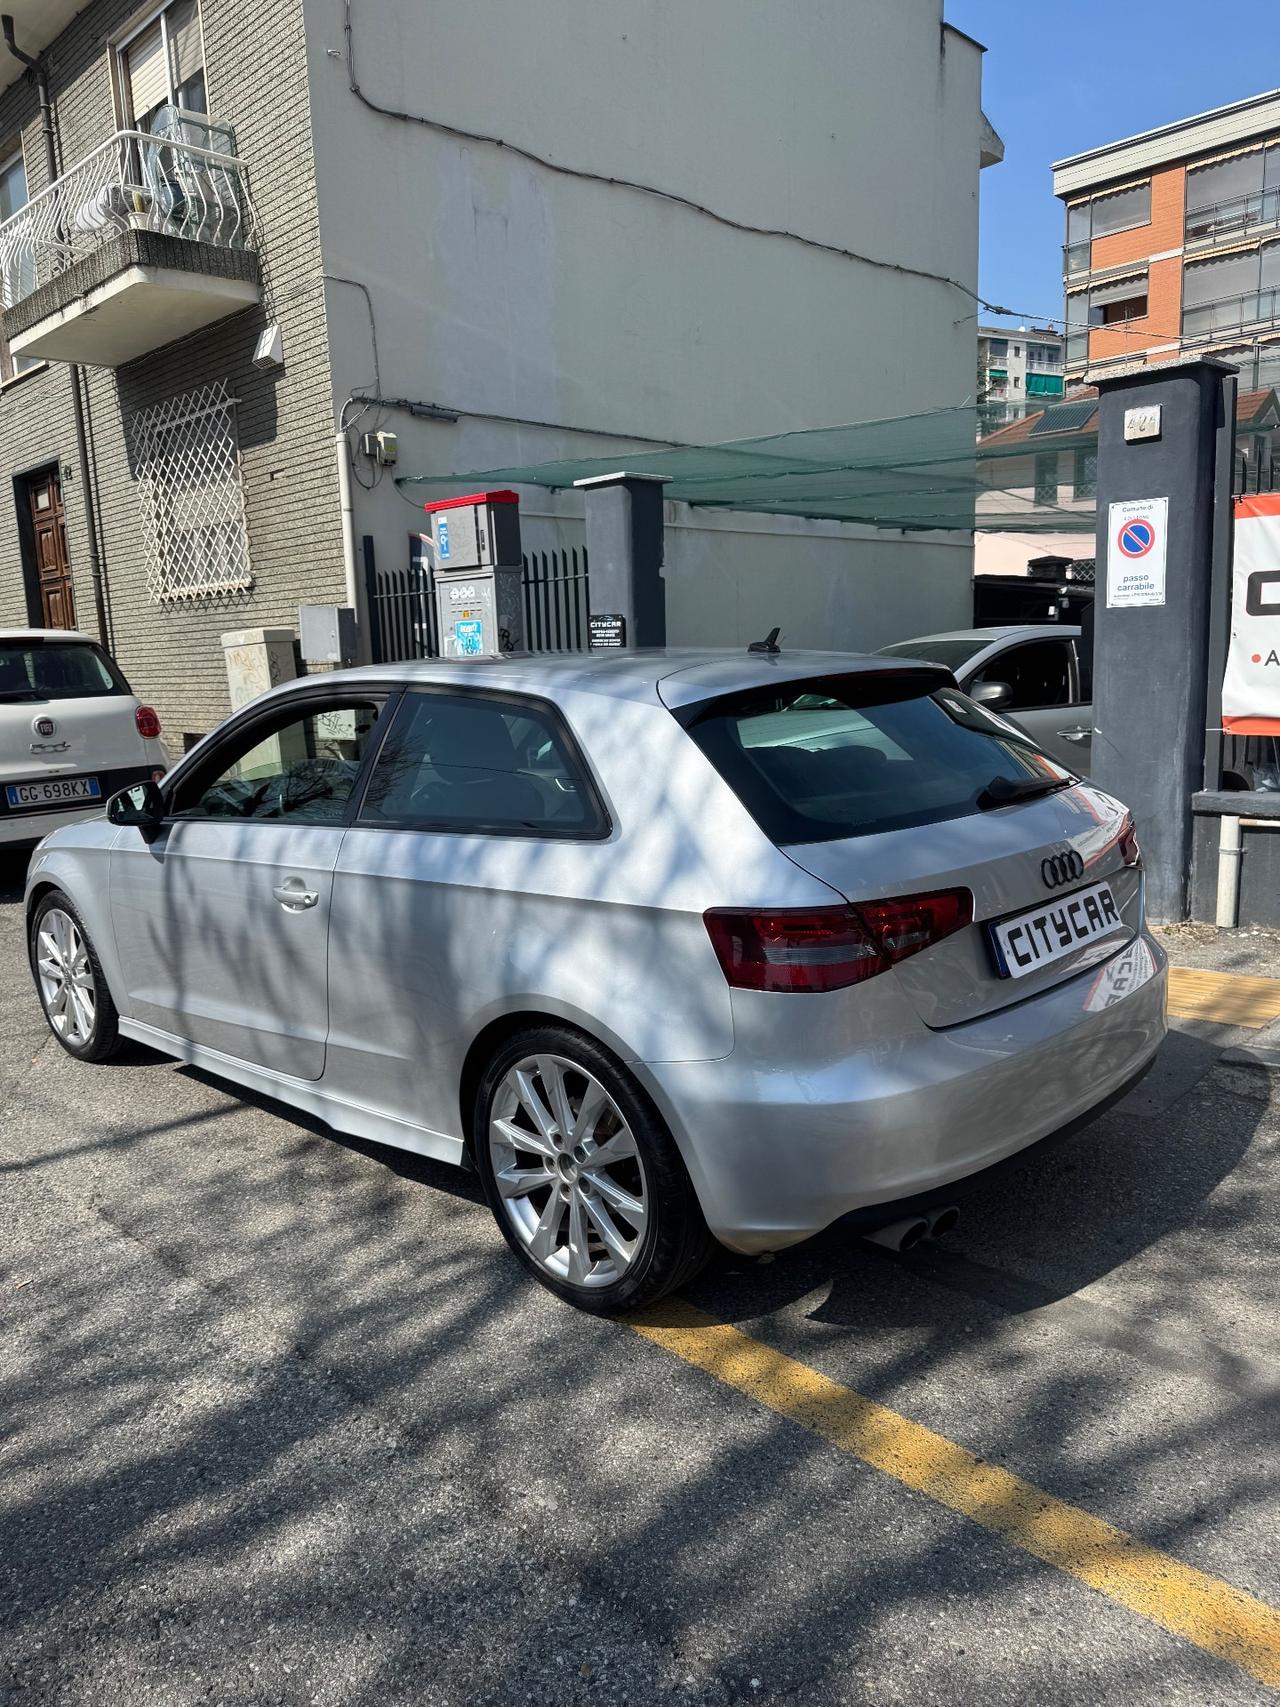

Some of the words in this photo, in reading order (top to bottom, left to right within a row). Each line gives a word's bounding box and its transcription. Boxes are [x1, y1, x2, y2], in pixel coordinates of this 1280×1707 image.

[1117, 582, 1155, 591] carrabile
[1123, 574, 1149, 584] passo
[19, 786, 39, 802] GG
[43, 781, 90, 798] 698KX
[1007, 889, 1119, 967] CITYCAR
